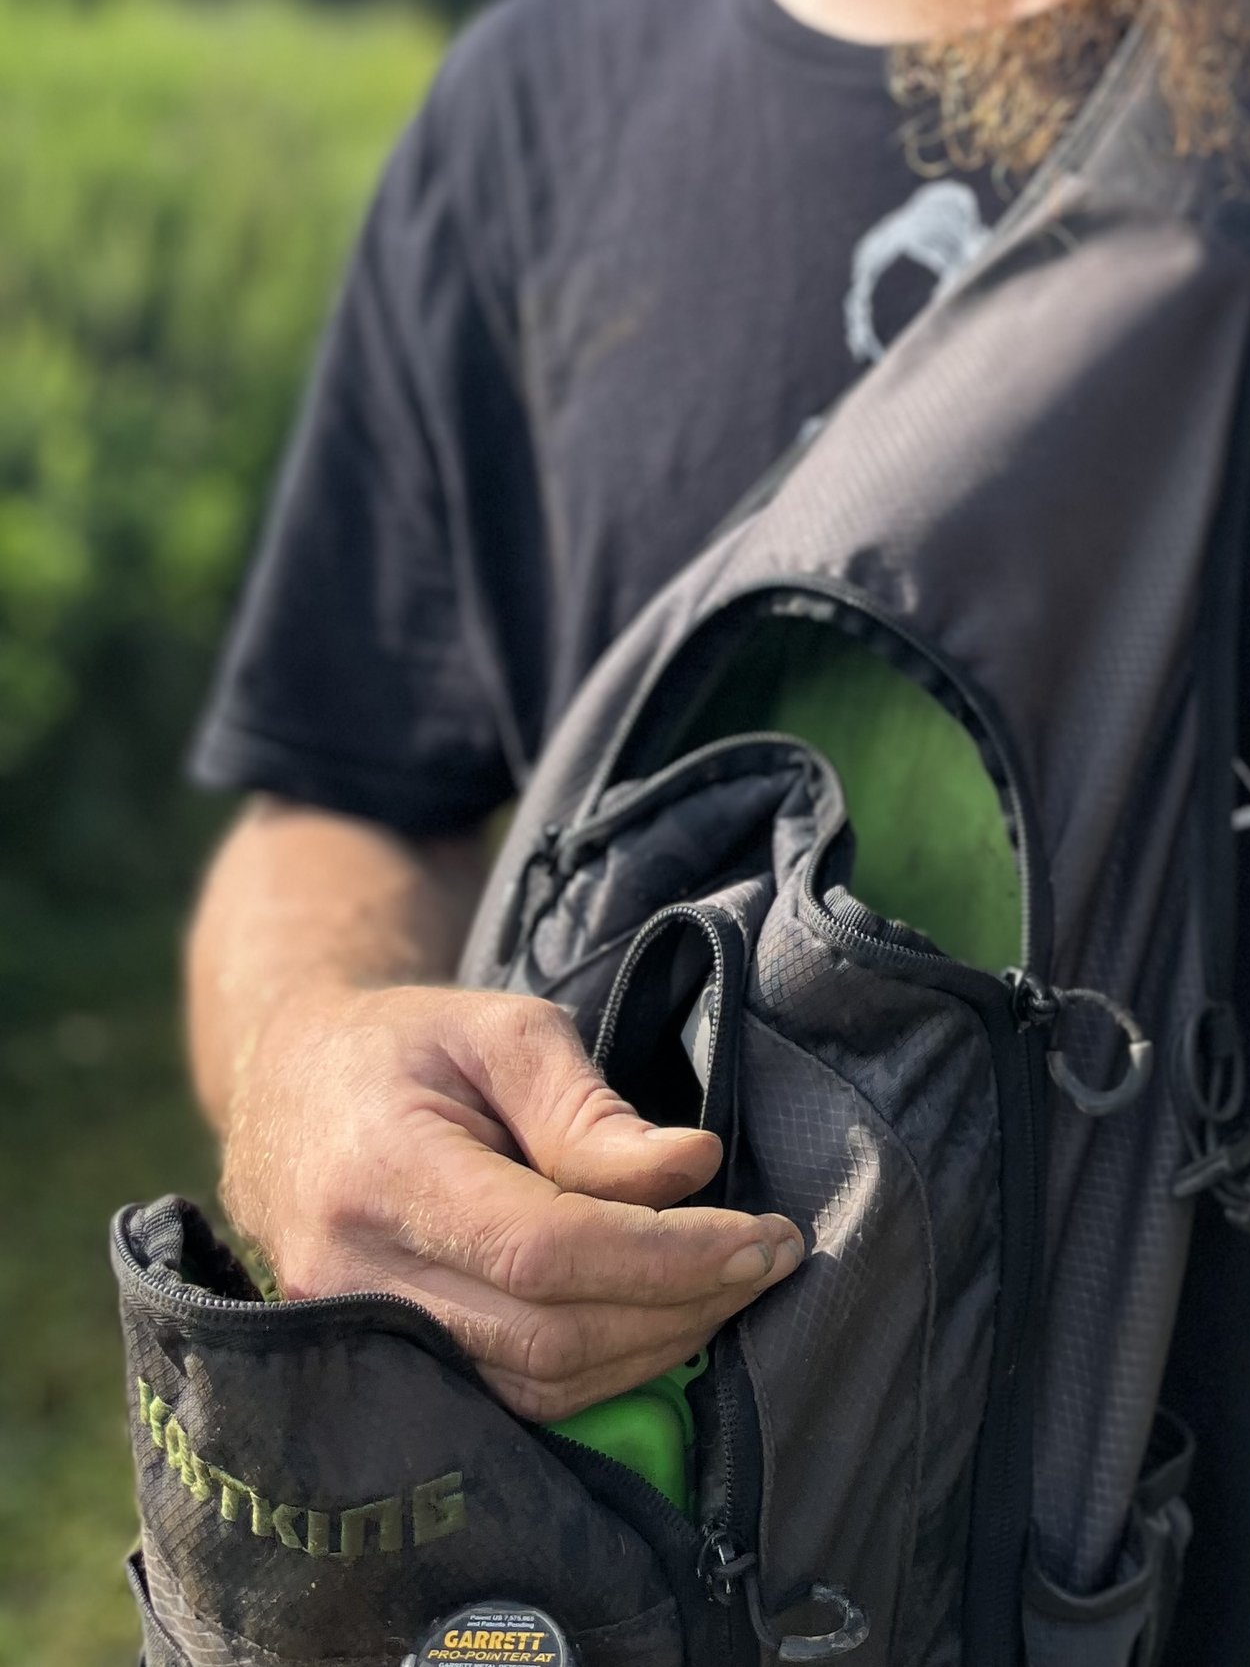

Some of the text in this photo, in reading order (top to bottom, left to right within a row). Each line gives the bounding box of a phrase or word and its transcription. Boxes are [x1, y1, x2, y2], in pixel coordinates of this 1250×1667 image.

[444, 1630, 545, 1650] GARRETT
[427, 1649, 557, 1662] PRO-POINTER AT
